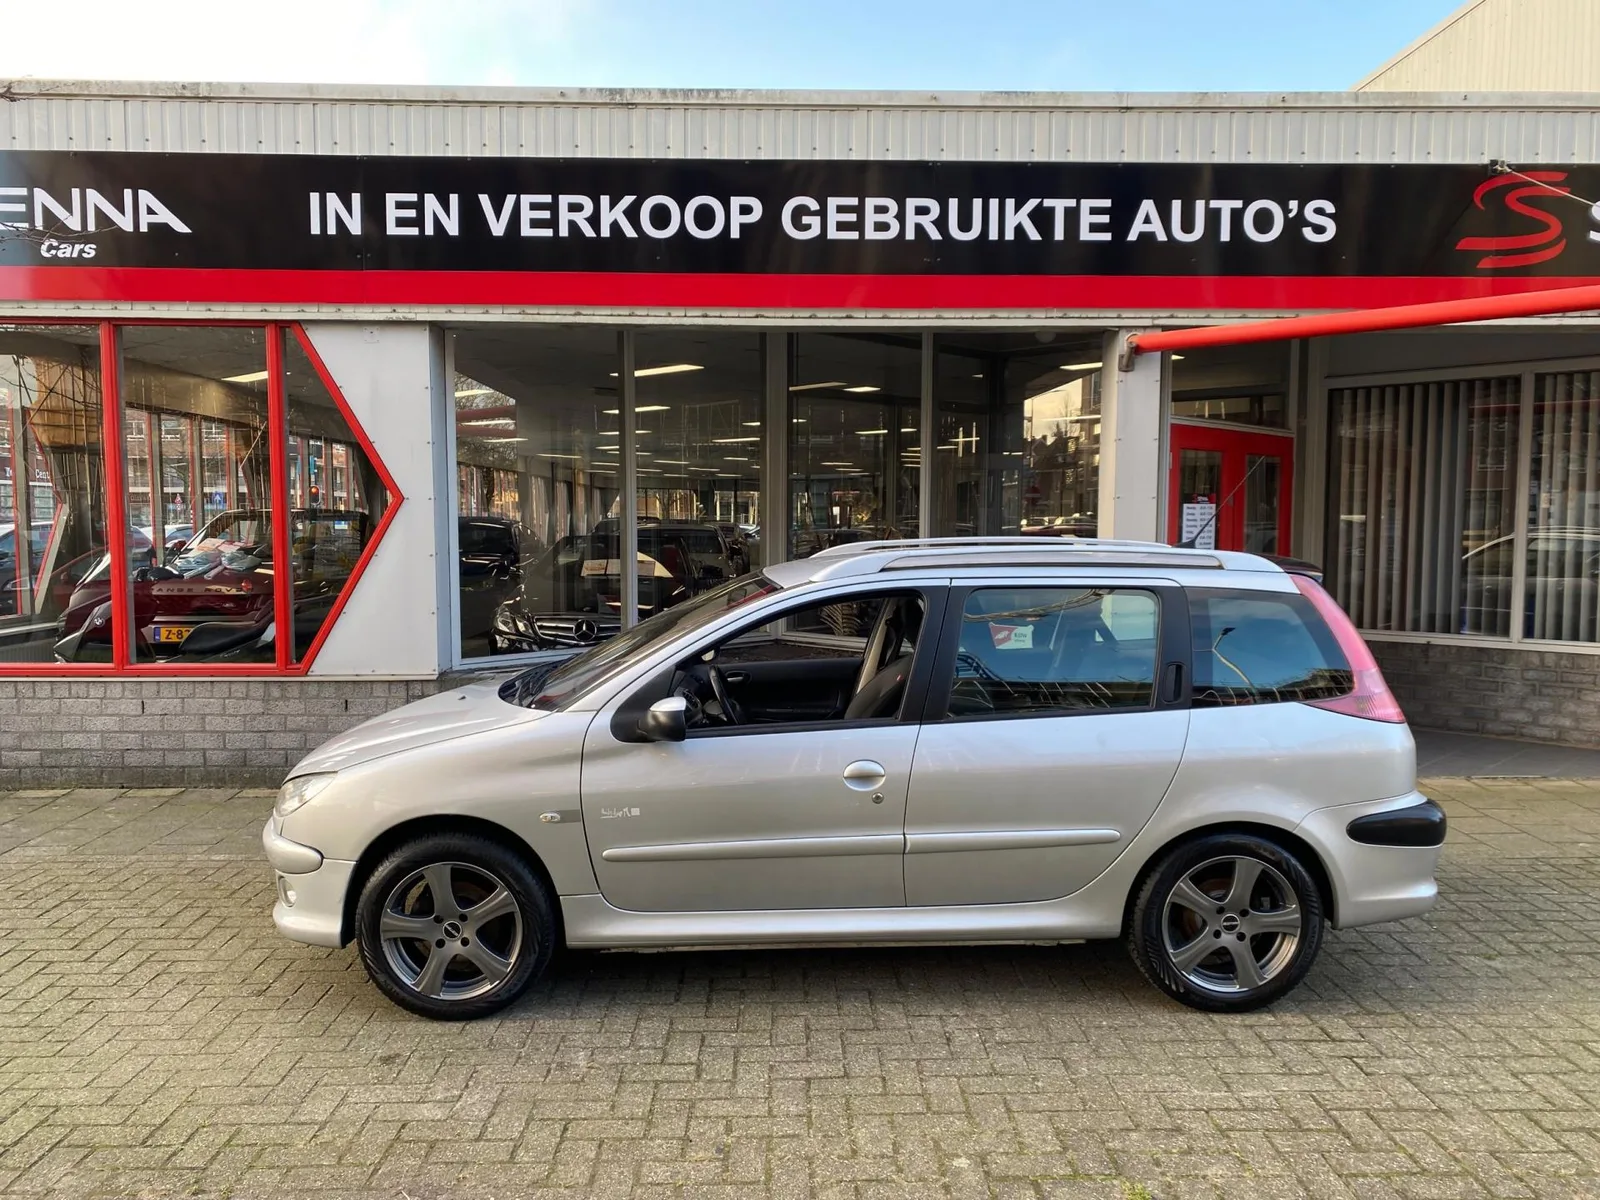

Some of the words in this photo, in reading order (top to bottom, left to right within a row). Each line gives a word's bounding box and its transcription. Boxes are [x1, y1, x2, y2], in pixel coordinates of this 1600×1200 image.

[309, 192, 362, 235] IN
[385, 192, 459, 236] EN
[477, 193, 763, 239] VERKOOP
[781, 195, 1112, 241] GEBRUIKTE
[1126, 199, 1337, 243] AUTO'S
[40, 238, 97, 259] Cars
